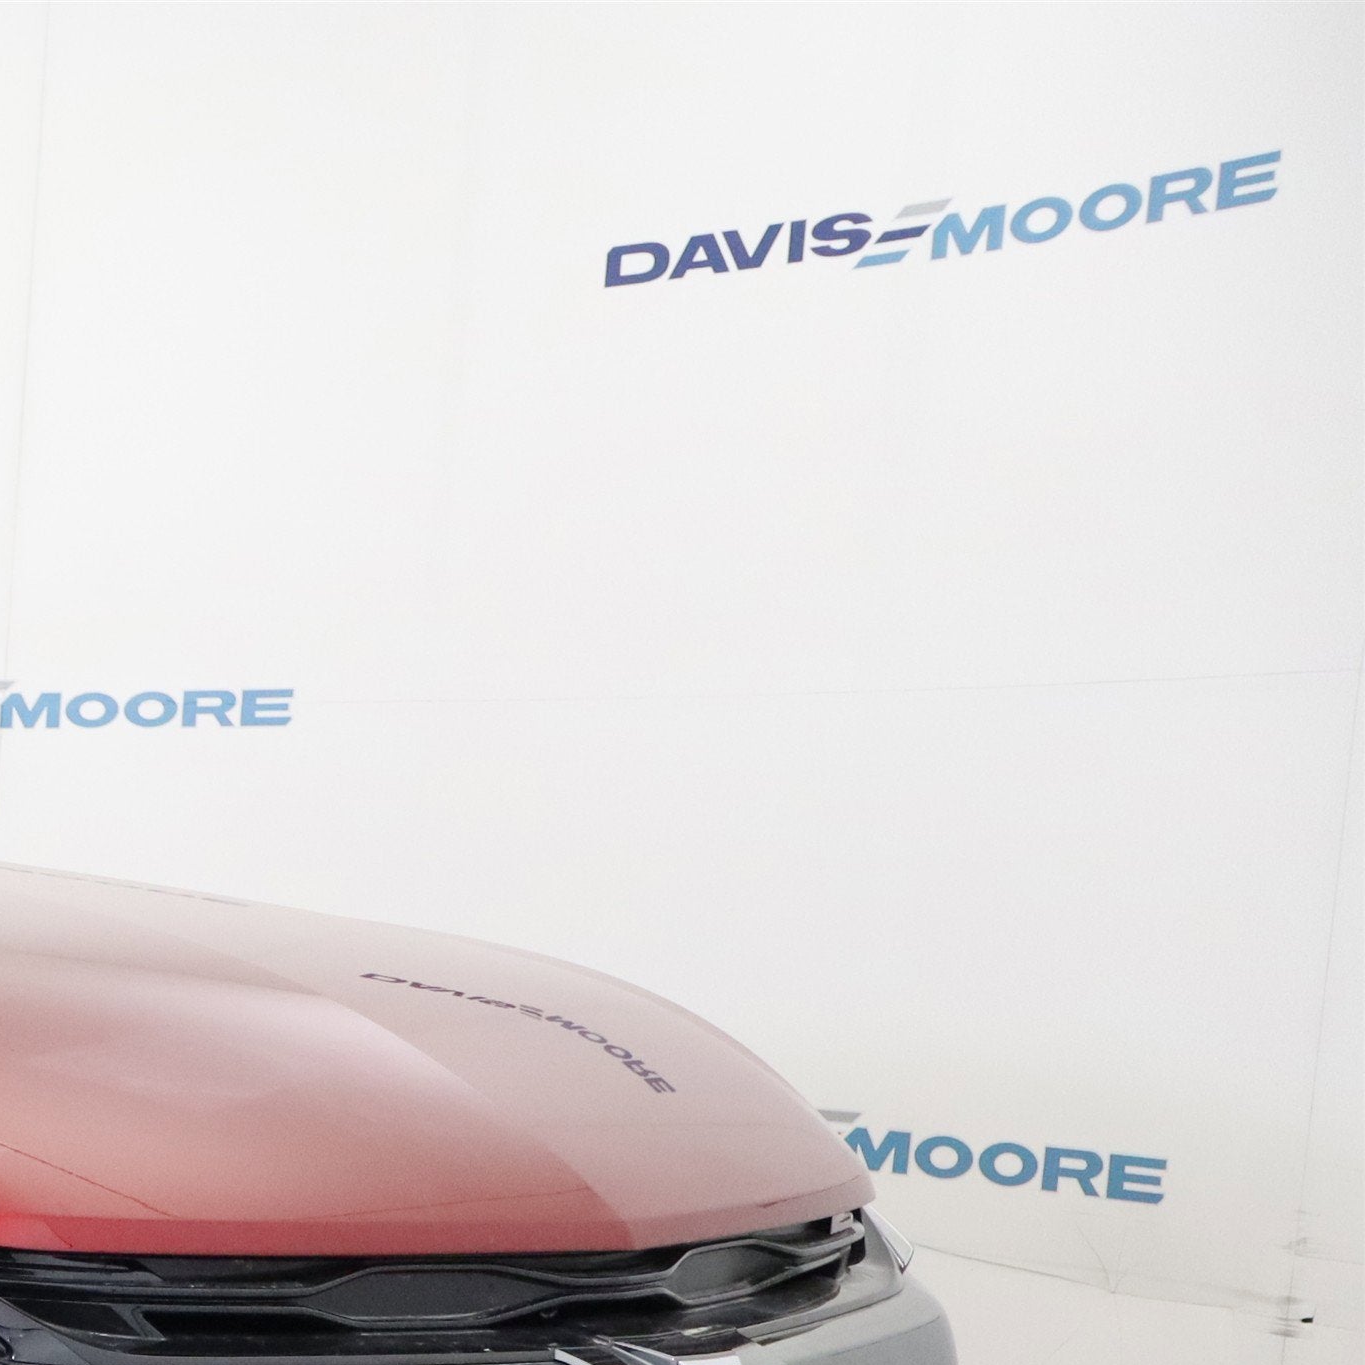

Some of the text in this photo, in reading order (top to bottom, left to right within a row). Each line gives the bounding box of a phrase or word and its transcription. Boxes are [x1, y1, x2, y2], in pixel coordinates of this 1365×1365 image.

[603, 150, 1282, 288] DAVIS MOORE
[0, 688, 294, 729] MOORE
[844, 1126, 1168, 1205] MOORE
